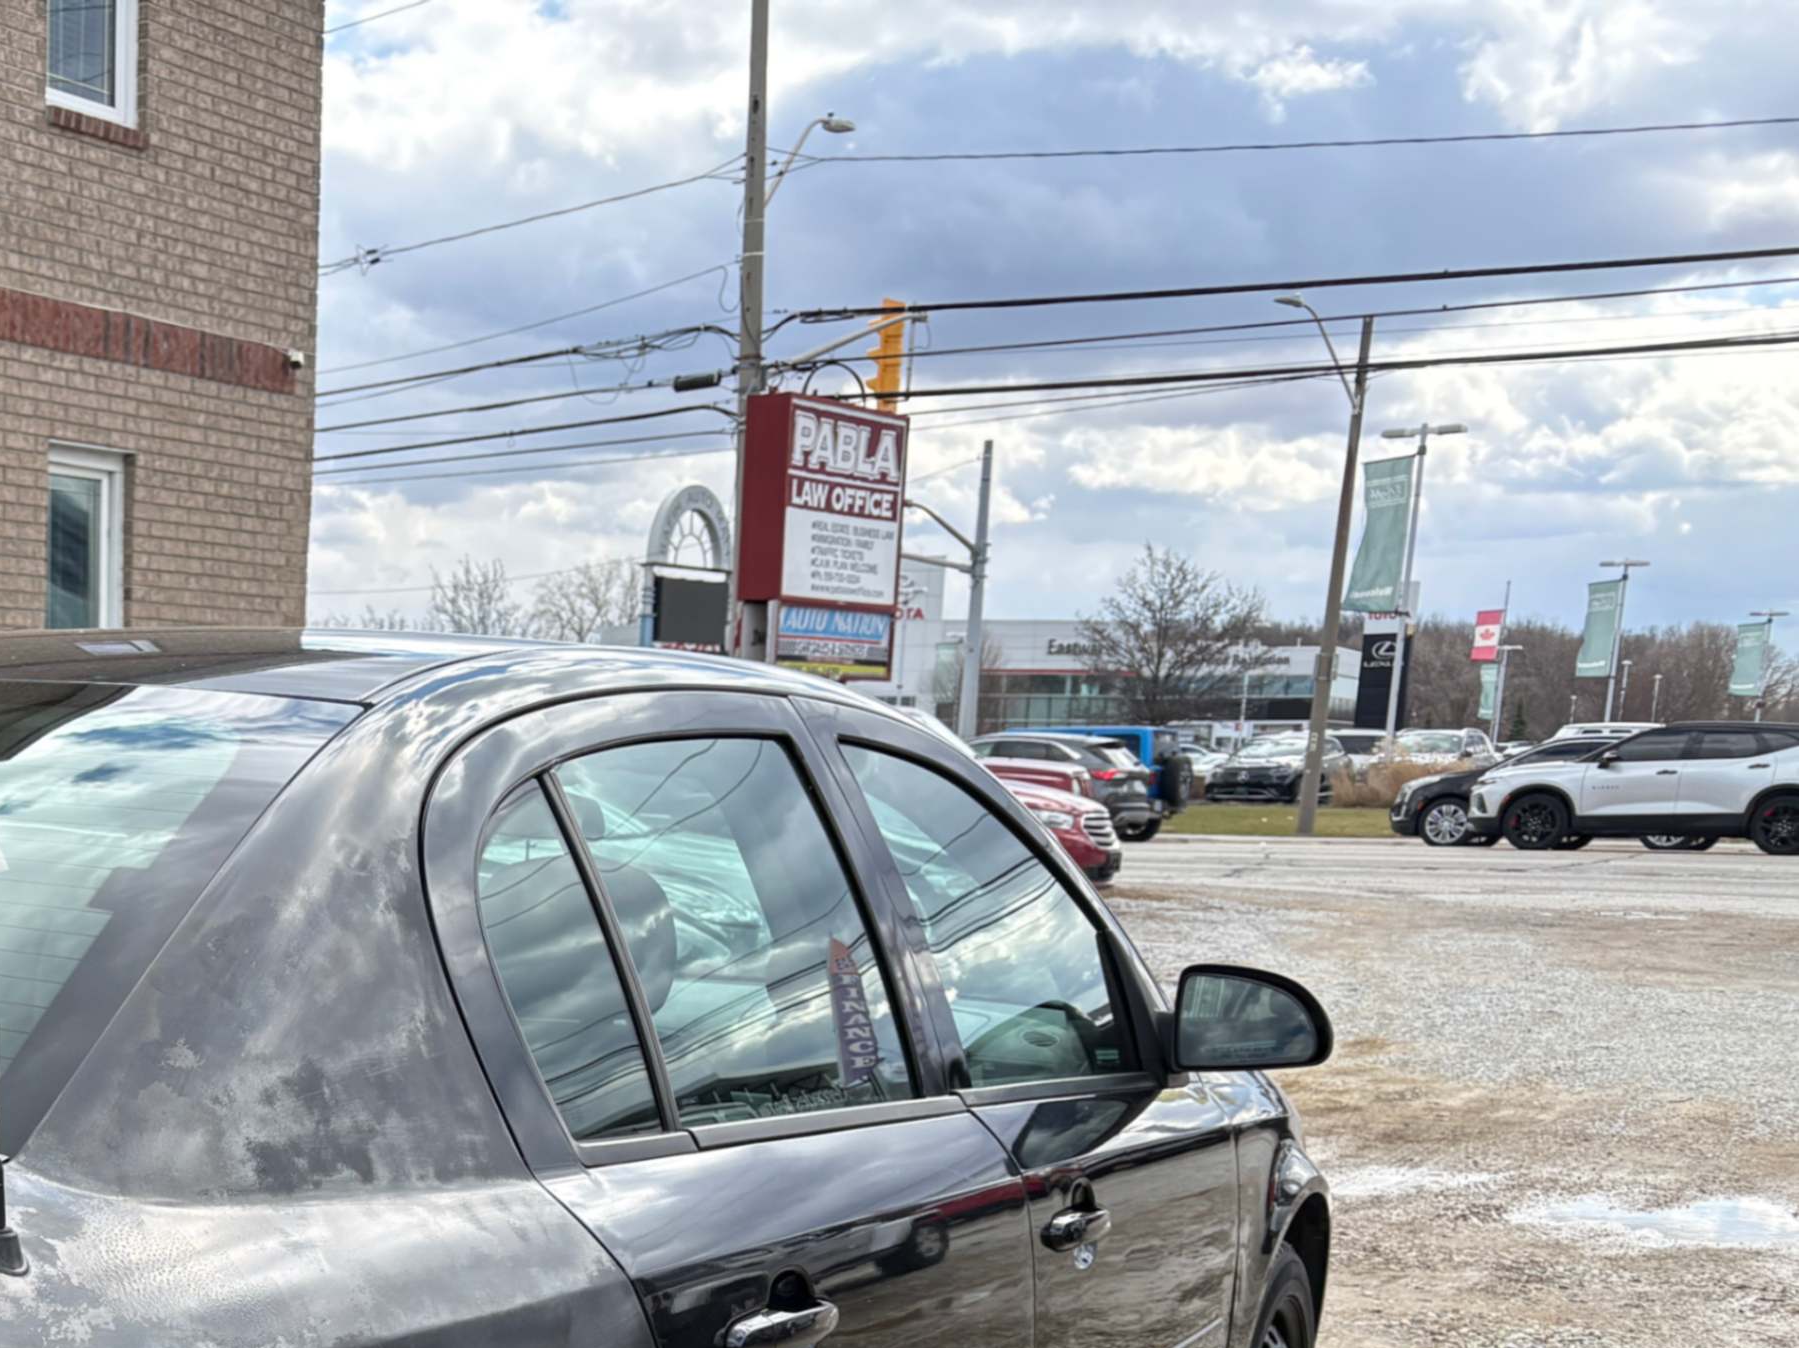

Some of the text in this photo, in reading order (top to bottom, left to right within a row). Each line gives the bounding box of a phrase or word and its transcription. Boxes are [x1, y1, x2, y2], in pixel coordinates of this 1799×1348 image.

[791, 409, 900, 482] PABLA
[791, 479, 895, 518] LAW OFFICE
[841, 974, 878, 1068] FINANCE
